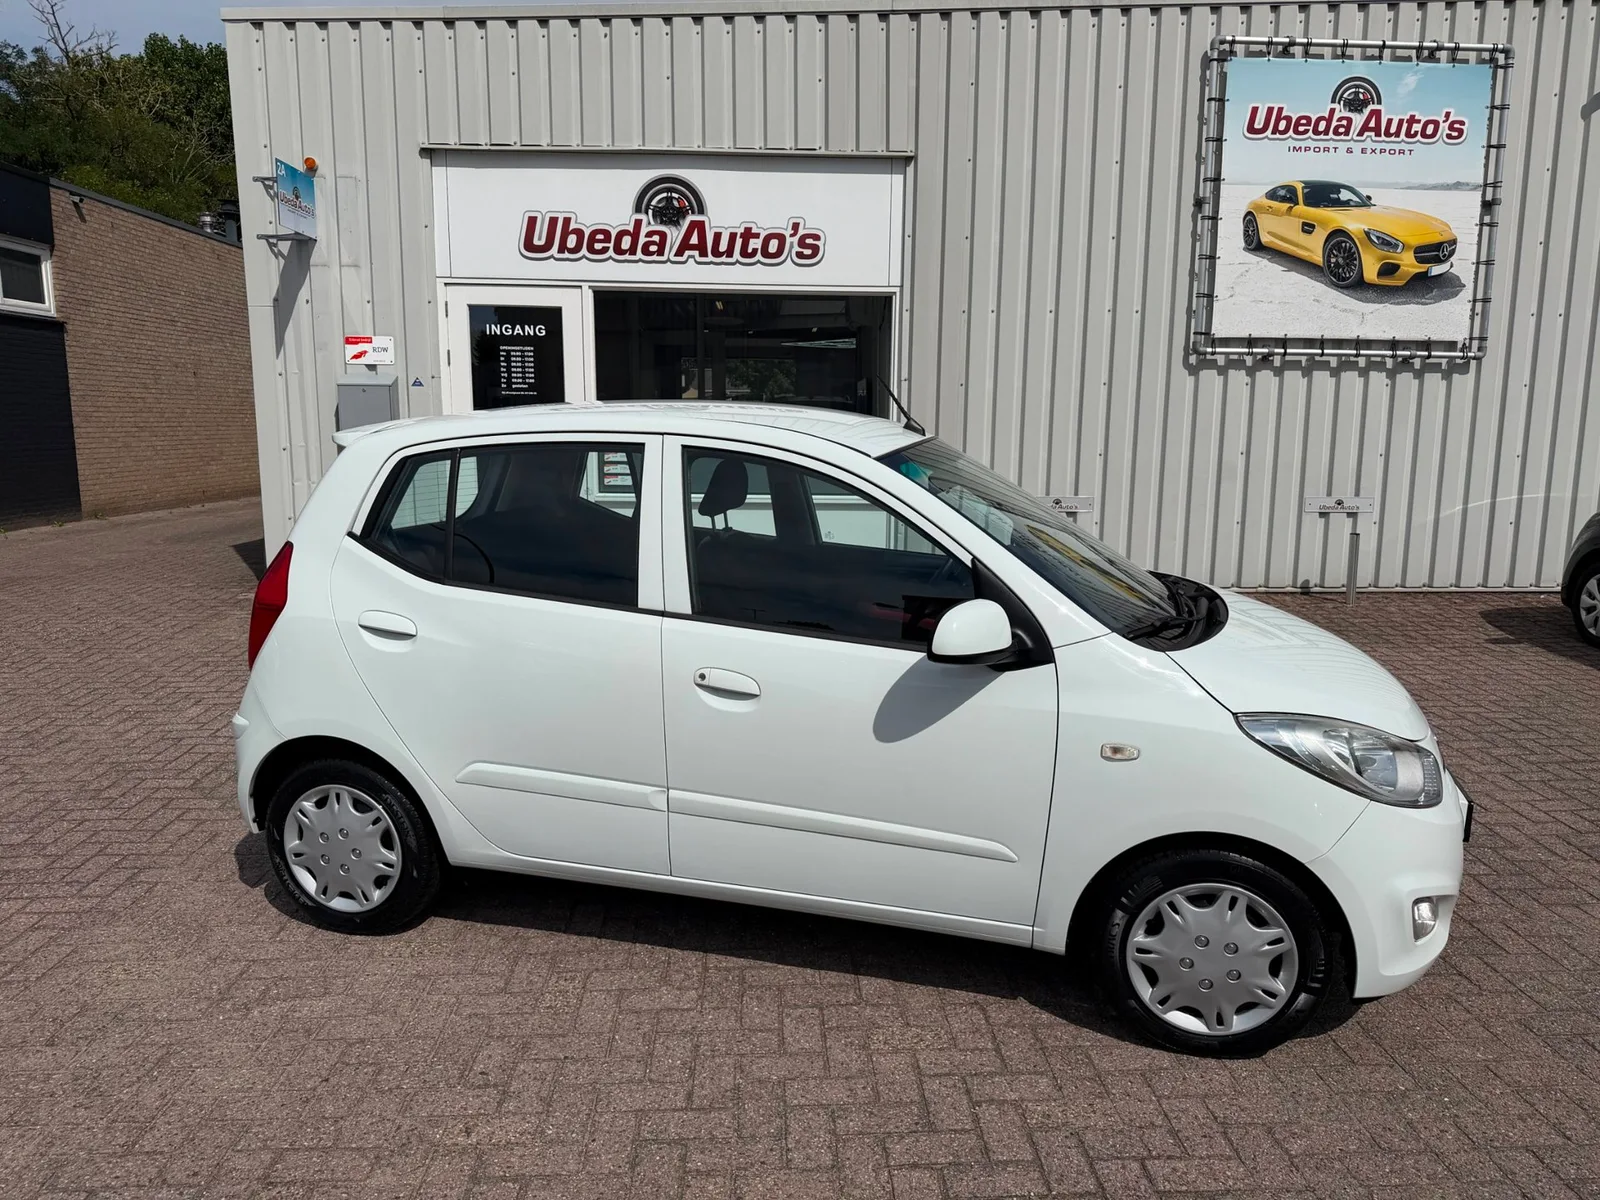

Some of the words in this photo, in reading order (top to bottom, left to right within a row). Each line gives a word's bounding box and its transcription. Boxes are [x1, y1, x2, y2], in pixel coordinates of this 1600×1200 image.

[1246, 106, 1353, 137] Ubeda
[1356, 108, 1466, 141] Auto's
[1287, 145, 1339, 154] IMPORT
[1360, 147, 1415, 156] EXPORT
[277, 162, 286, 178] 2A
[279, 190, 298, 209] Ubeda
[297, 199, 315, 218] Auto's
[522, 215, 668, 258] Ubeda
[672, 218, 822, 261] Auto's
[486, 323, 546, 337] INGANG
